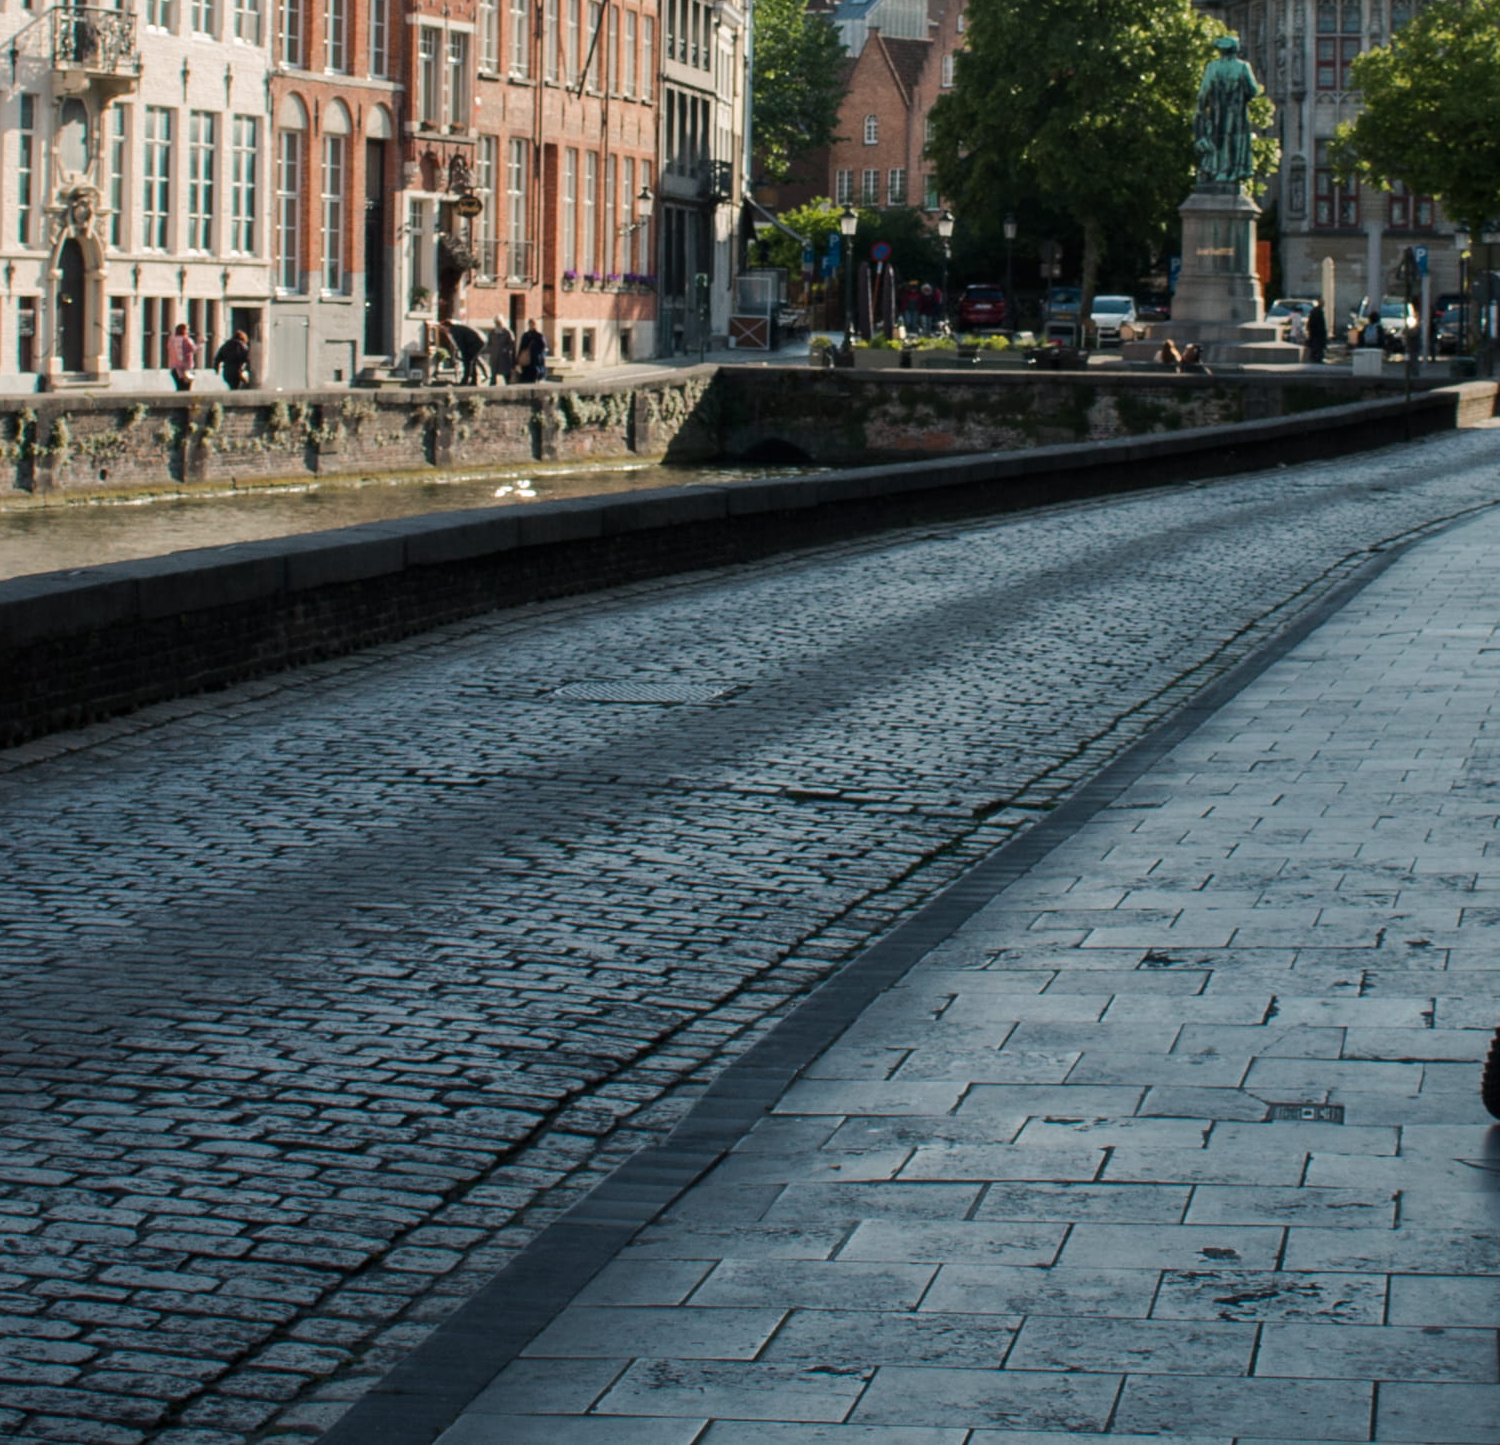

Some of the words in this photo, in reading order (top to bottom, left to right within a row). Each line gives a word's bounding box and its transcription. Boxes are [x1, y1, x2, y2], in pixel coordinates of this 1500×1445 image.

[830, 234, 840, 248] P
[1416, 248, 1427, 263] P
[1171, 257, 1181, 272] P
